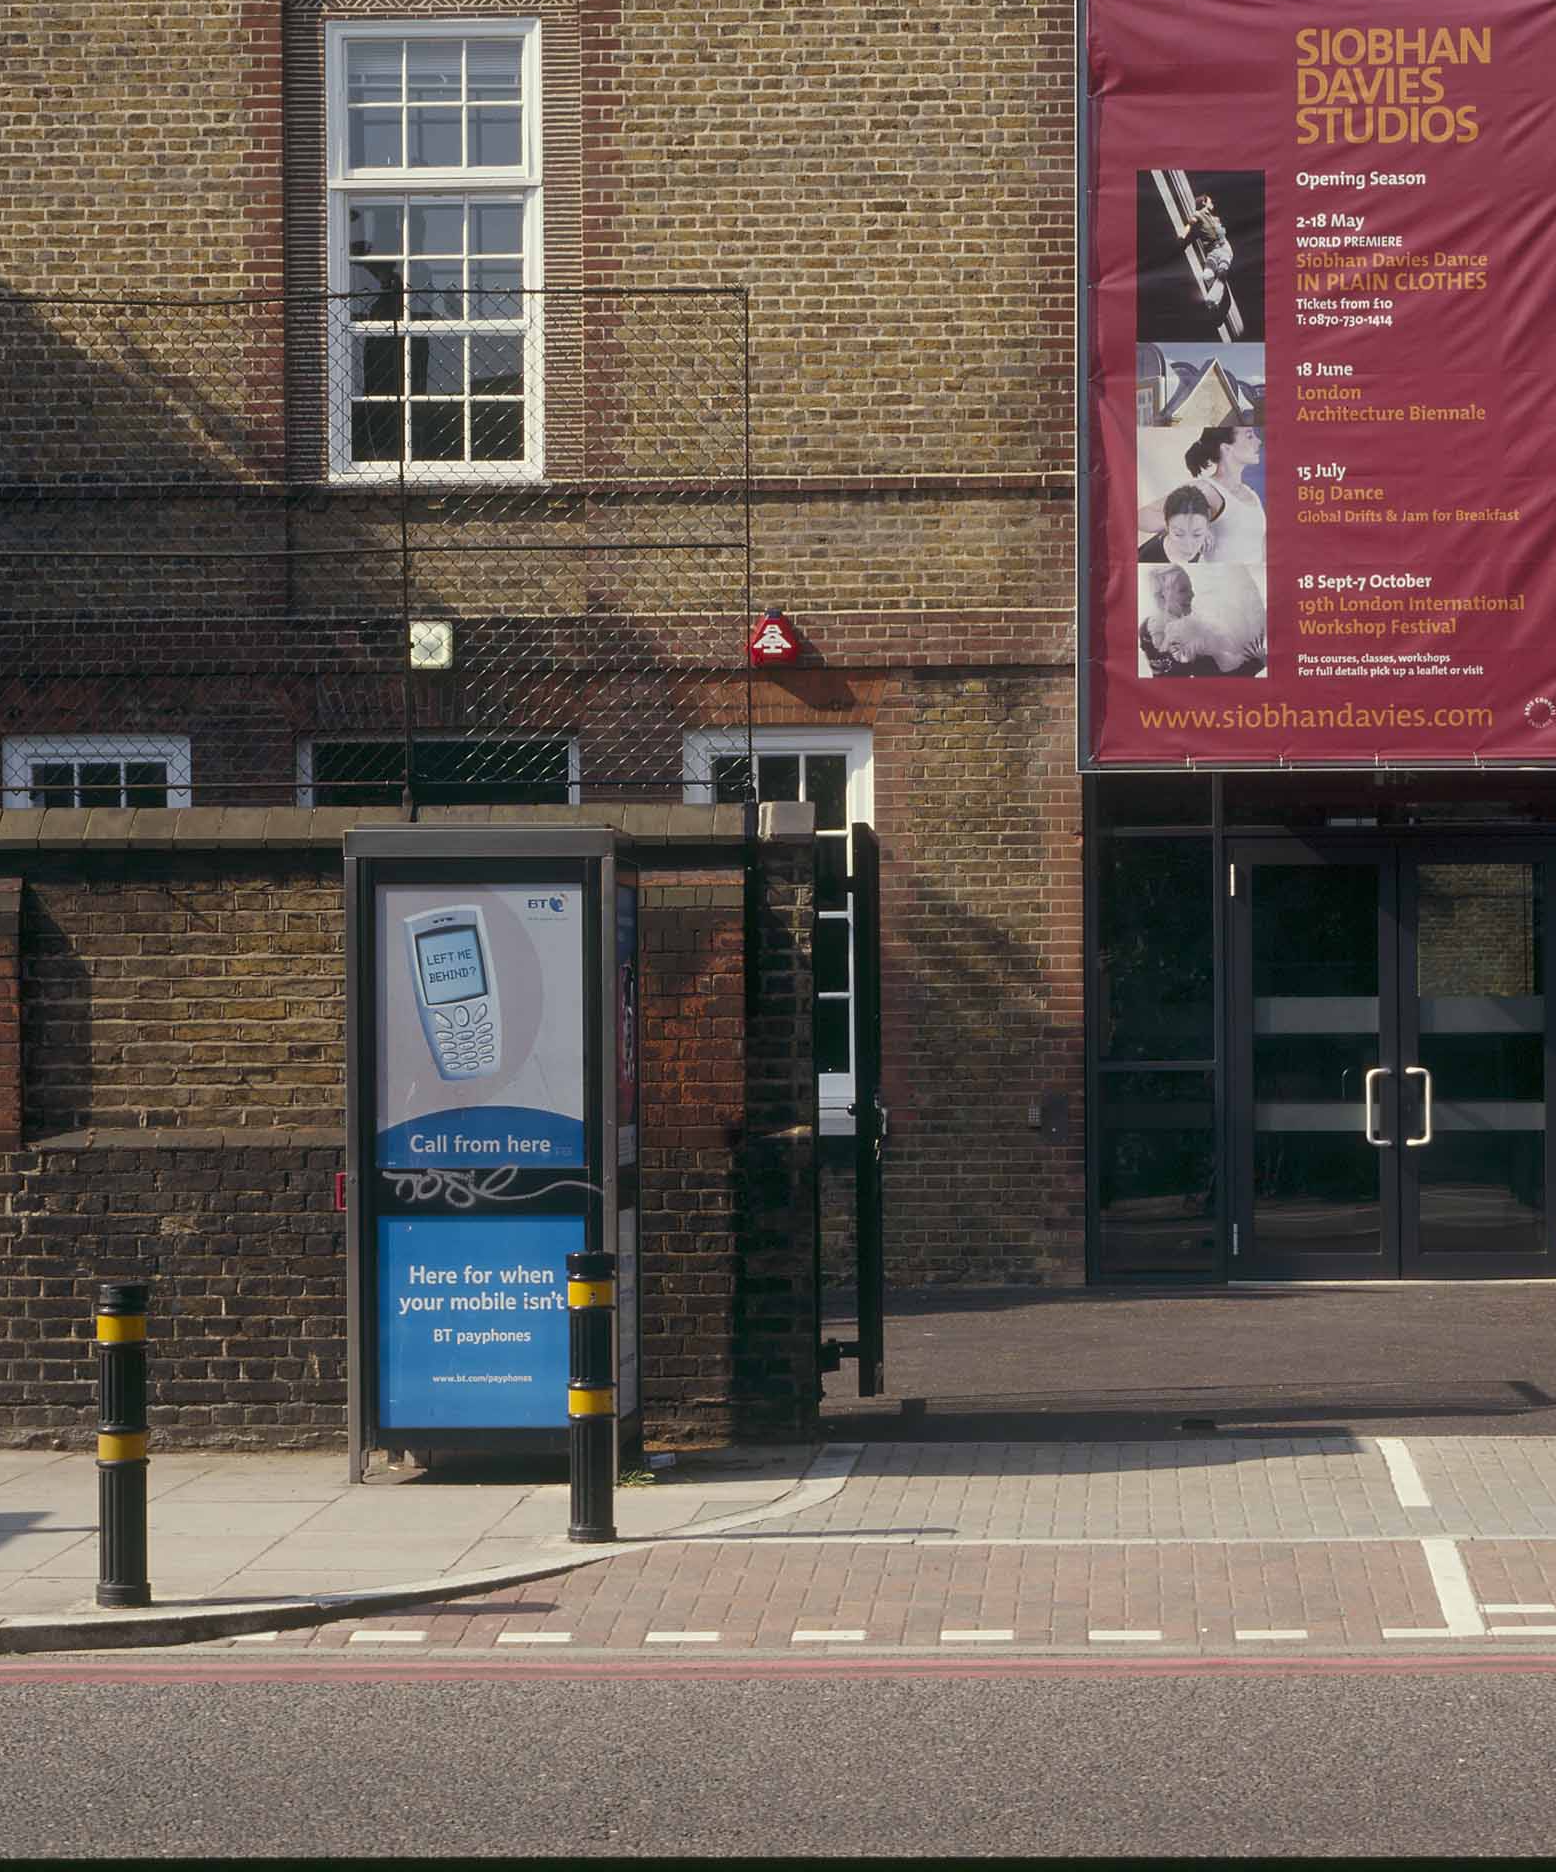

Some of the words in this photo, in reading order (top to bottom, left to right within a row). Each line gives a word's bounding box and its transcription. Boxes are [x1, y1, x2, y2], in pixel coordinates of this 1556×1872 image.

[1296, 27, 1492, 65] SIOBHAN
[1297, 66, 1444, 105] DAVIES
[1296, 105, 1479, 145] STUDIOS
[1295, 171, 1365, 190] Opening
[1370, 171, 1427, 186] Season
[1295, 213, 1327, 228] 2-18
[1331, 213, 1365, 231] May
[1296, 236, 1341, 248] WORLD
[1343, 235, 1403, 248] PREMIERE
[1296, 252, 1368, 268] Siobhan
[1372, 251, 1429, 267] Davies
[1434, 252, 1489, 267] Dance
[1297, 273, 1320, 292] IN
[1327, 273, 1388, 291] PLAIN
[1394, 271, 1487, 291] CLOTHES
[1295, 298, 1337, 310] Tickets
[1340, 297, 1370, 310] from
[1373, 298, 1394, 310] £10
[1295, 314, 1306, 325] T:
[1309, 313, 1393, 327] 0870-730-1414
[1296, 362, 1312, 376] 18
[1316, 362, 1354, 377] June
[1296, 384, 1362, 401] London
[1296, 405, 1405, 422] Architecture
[1409, 403, 1486, 421] Biennale
[1296, 465, 1311, 481] 15
[1315, 462, 1346, 481] July
[1297, 485, 1325, 504] Big
[1330, 485, 1385, 501] Dance
[1297, 509, 1341, 523] Global
[1345, 509, 1382, 523] Drifts
[1386, 510, 1398, 522] &
[1402, 509, 1429, 523] Jam
[1432, 509, 1453, 522] for
[1455, 508, 1521, 522] Breakfast
[1297, 574, 1314, 589] 18
[1317, 574, 1365, 592] Sept-7
[1369, 573, 1432, 589] October
[1298, 595, 1334, 615] 19th
[1339, 595, 1404, 612] London
[1409, 593, 1525, 612] International
[1298, 618, 1386, 638] Workshop
[1391, 617, 1457, 634] Festival
[1297, 653, 1319, 663] Plus
[1320, 654, 1359, 665] courses,
[1361, 653, 1396, 664] classes,
[1398, 653, 1451, 664] workshops
[1298, 666, 1314, 677] For
[1316, 665, 1333, 677] full
[1334, 666, 1368, 677] details
[1370, 665, 1390, 678] pick
[1392, 667, 1406, 678] up
[1408, 667, 1415, 675] a
[1416, 665, 1448, 676] leaflet
[1450, 667, 1461, 675] or
[1462, 665, 1484, 675] visit
[1139, 702, 1493, 729] www.siobhandavies.com
[527, 899, 548, 909] BT
[426, 951, 455, 966] LEFT
[458, 948, 474, 961] ME
[428, 965, 478, 984] BEHIND?
[409, 1134, 448, 1153] Call
[453, 1134, 501, 1153] from
[507, 1134, 552, 1153] here
[409, 1264, 458, 1285] Here
[463, 1264, 492, 1284] for
[499, 1264, 555, 1284] when
[399, 1296, 445, 1315] your
[450, 1291, 517, 1311] mobile
[523, 1290, 565, 1310] isn't
[433, 1328, 453, 1343] BT
[456, 1327, 532, 1345] payphones
[432, 1372, 533, 1385] www.bt.com/payphones
